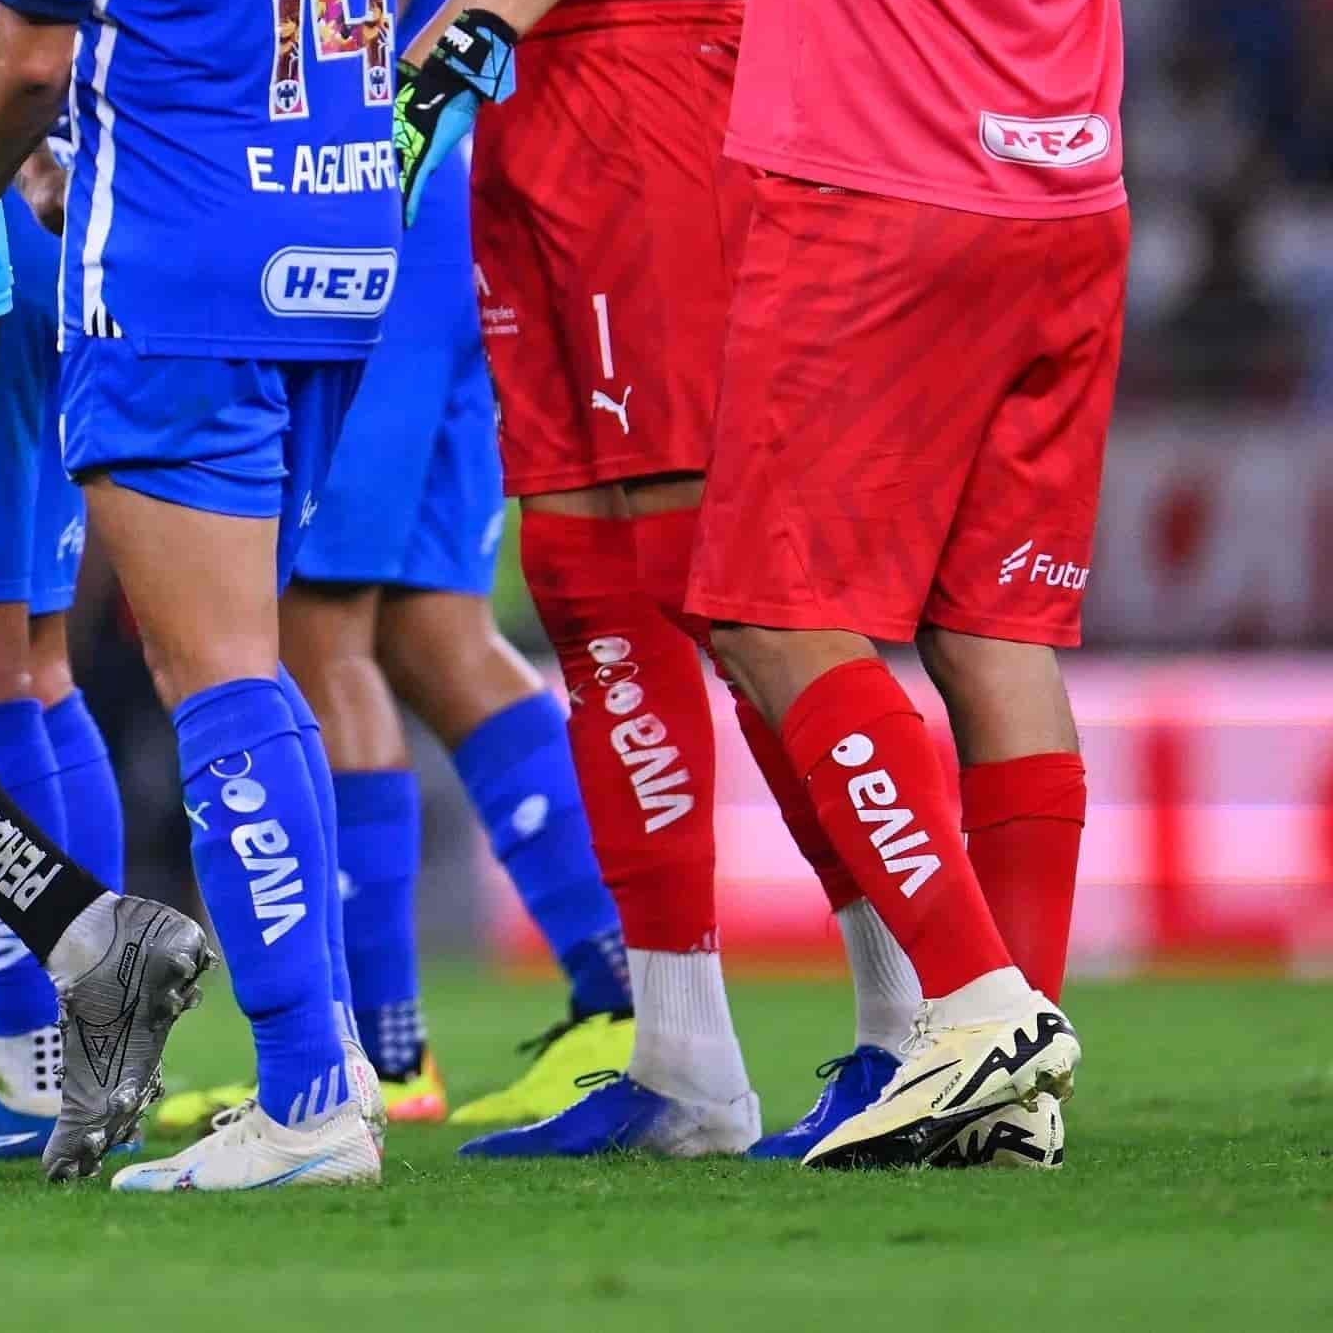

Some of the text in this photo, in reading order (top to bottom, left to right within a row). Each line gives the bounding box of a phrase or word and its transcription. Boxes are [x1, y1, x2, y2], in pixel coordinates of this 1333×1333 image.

[592, 292, 615, 379] 1
[230, 818, 307, 947] viva
[847, 768, 942, 899] viva
